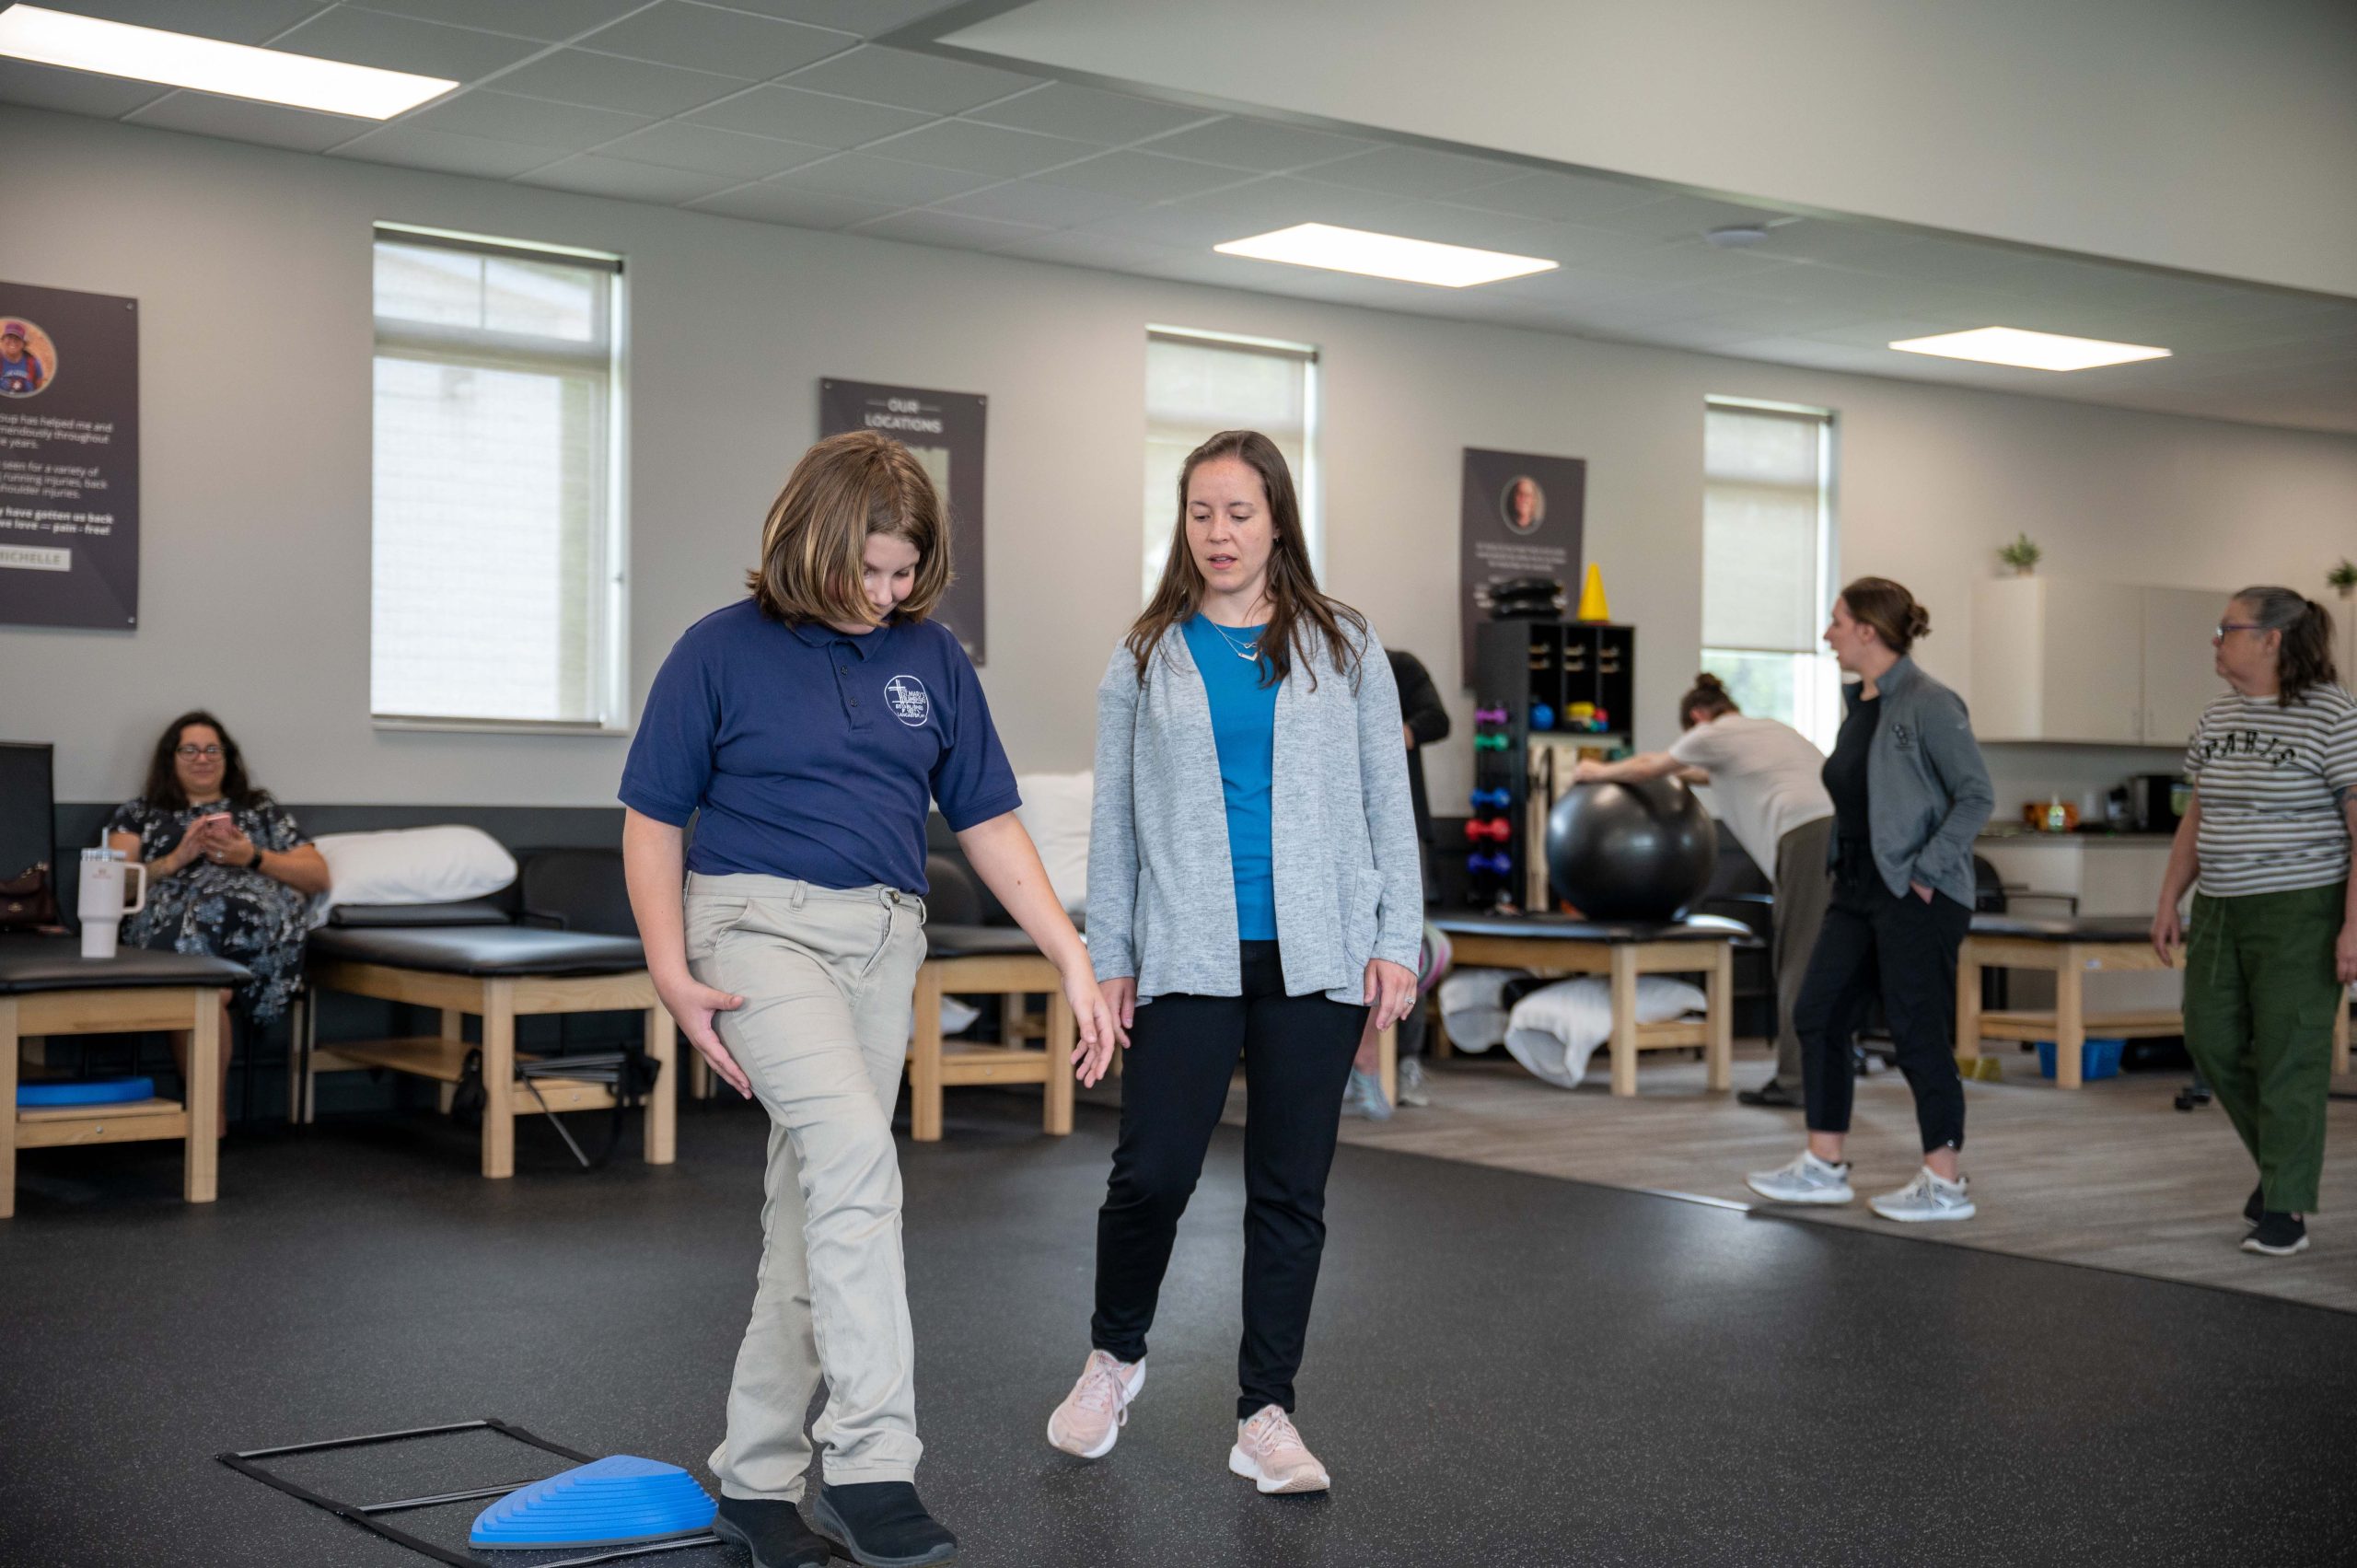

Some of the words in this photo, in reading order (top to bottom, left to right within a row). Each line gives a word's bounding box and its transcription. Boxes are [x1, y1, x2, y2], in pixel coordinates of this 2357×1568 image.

[888, 398, 919, 413] OUR
[20, 412, 38, 425] has
[40, 414, 75, 430] helped
[75, 420, 92, 432] me
[93, 422, 113, 433] and
[865, 413, 943, 434] LOCATIONS
[53, 429, 110, 444] throughout
[2, 461, 26, 471] seen
[28, 460, 42, 472] for
[44, 464, 52, 473] a
[53, 464, 87, 478] variety
[87, 466, 99, 477] of
[4, 472, 42, 486] running
[84, 477, 108, 490] back
[6, 505, 33, 518] have
[35, 509, 72, 522] gotten
[73, 512, 86, 523] us
[87, 512, 114, 525] back
[14, 518, 39, 530] love
[52, 522, 77, 534] pain
